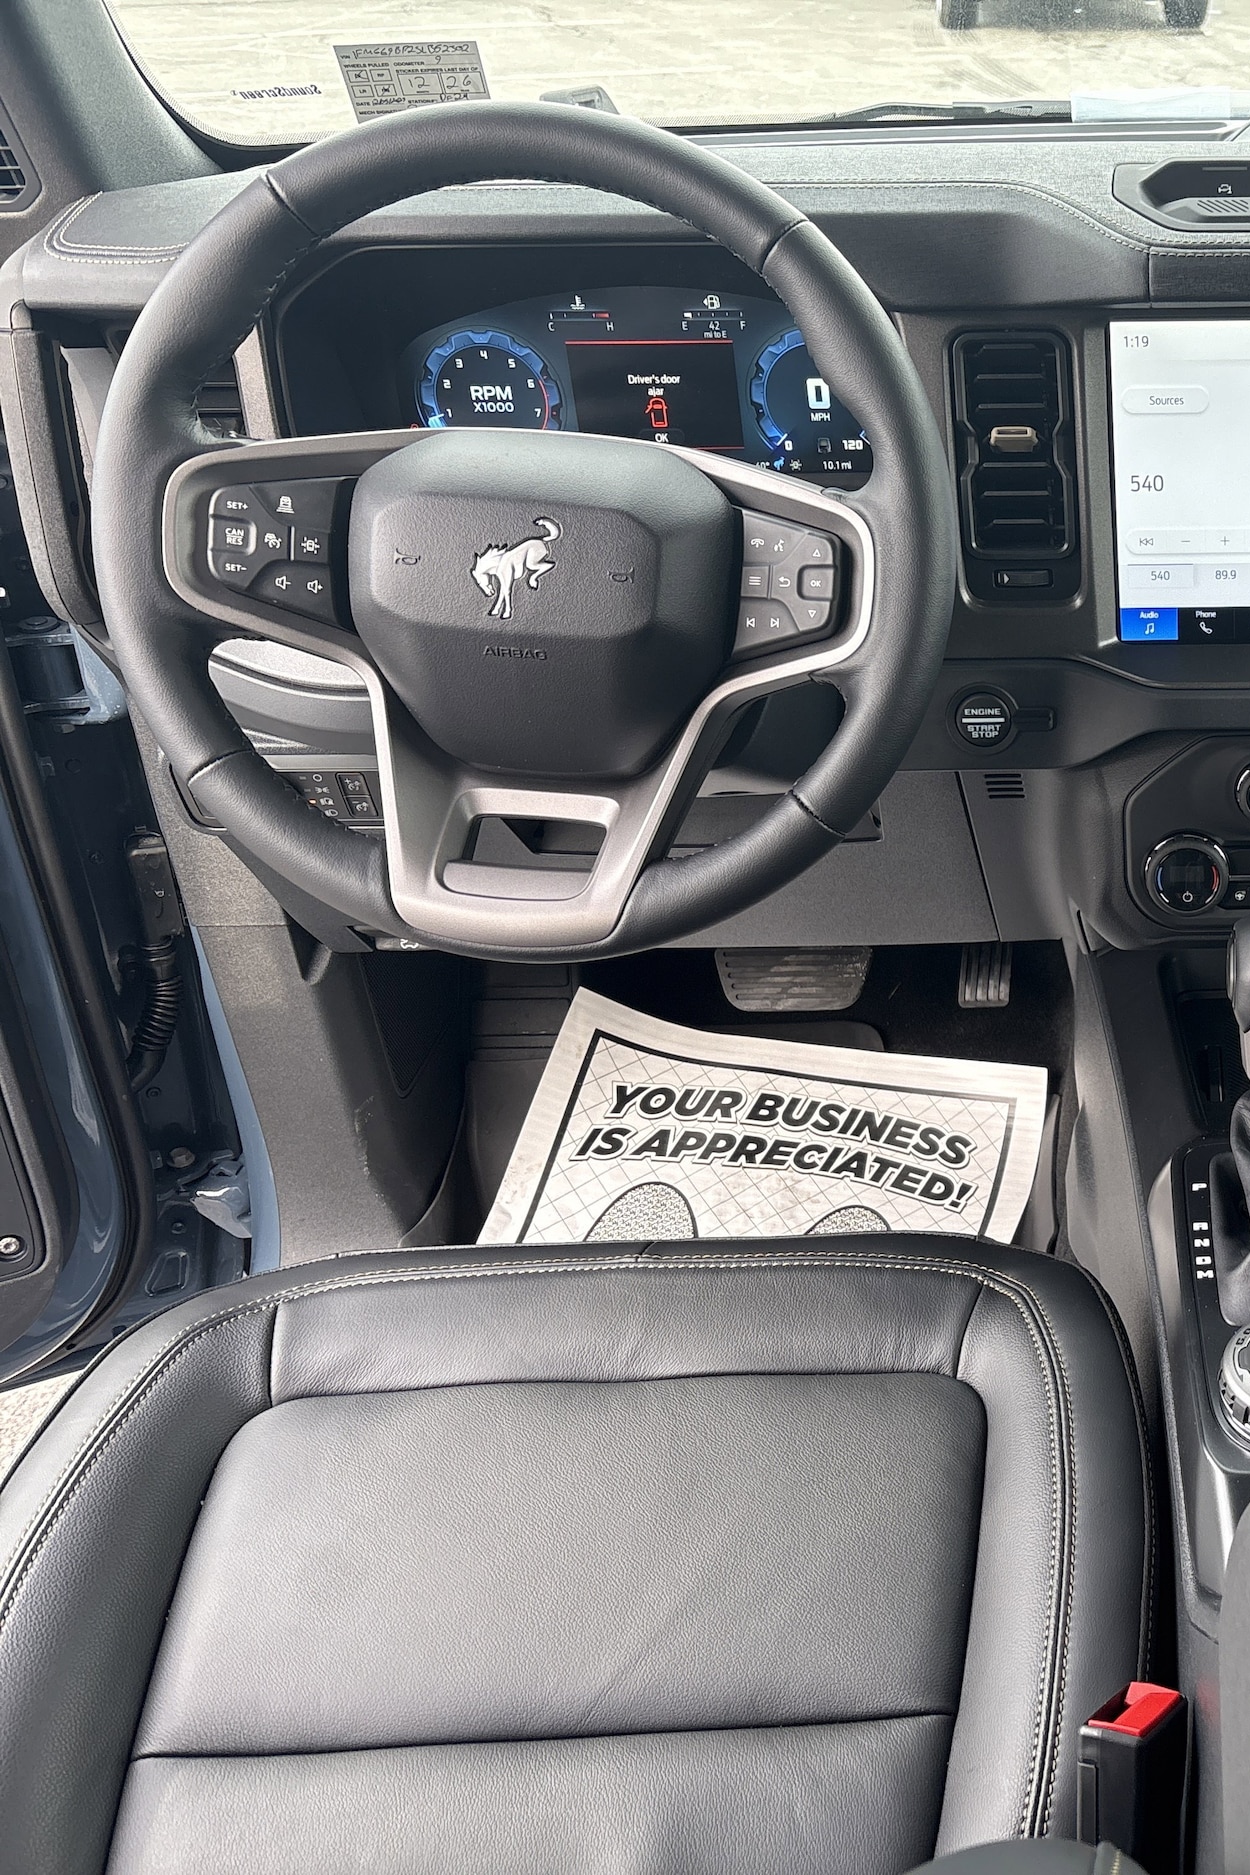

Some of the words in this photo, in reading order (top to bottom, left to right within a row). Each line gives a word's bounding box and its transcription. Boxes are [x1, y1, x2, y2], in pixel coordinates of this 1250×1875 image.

[446, 74, 472, 89] 26
[548, 321, 555, 331] C
[606, 322, 614, 331] H
[682, 321, 688, 330] E
[709, 321, 720, 330] 42
[740, 321, 746, 330] F
[1123, 335, 1149, 348] 1:19
[480, 350, 488, 359] 4
[455, 359, 463, 368] 3
[508, 359, 516, 368] 5
[443, 379, 451, 389] 2
[527, 379, 535, 388] 6
[627, 374, 660, 385] Driver's
[660, 374, 681, 384] door
[469, 385, 513, 401] RPM
[648, 387, 664, 396] ajar
[1149, 395, 1184, 405] Sources
[473, 402, 515, 413] X1000
[534, 408, 541, 418] 7
[810, 412, 831, 422] MPH
[655, 433, 669, 443] OK
[842, 439, 864, 450] 120
[822, 461, 840, 470] 10.1
[841, 461, 852, 470] mi
[1130, 474, 1164, 492] 540
[225, 527, 244, 537] CAN
[226, 537, 244, 546] RES
[1150, 570, 1170, 581] 540
[1215, 569, 1237, 580] 89.9
[1139, 611, 1159, 619] Audio
[1195, 610, 1216, 618] Phone
[482, 645, 548, 661] AIRBAG
[964, 708, 1001, 716] ENGINE
[967, 724, 1001, 732] START
[607, 1083, 741, 1120] YOUR
[746, 1092, 974, 1166] BUSINESS
[576, 1127, 636, 1158] IS
[632, 1129, 973, 1209] APPRECIATED!
[1192, 1183, 1207, 1191] P
[1194, 1239, 1210, 1247] N
[1197, 1270, 1214, 1279] M
